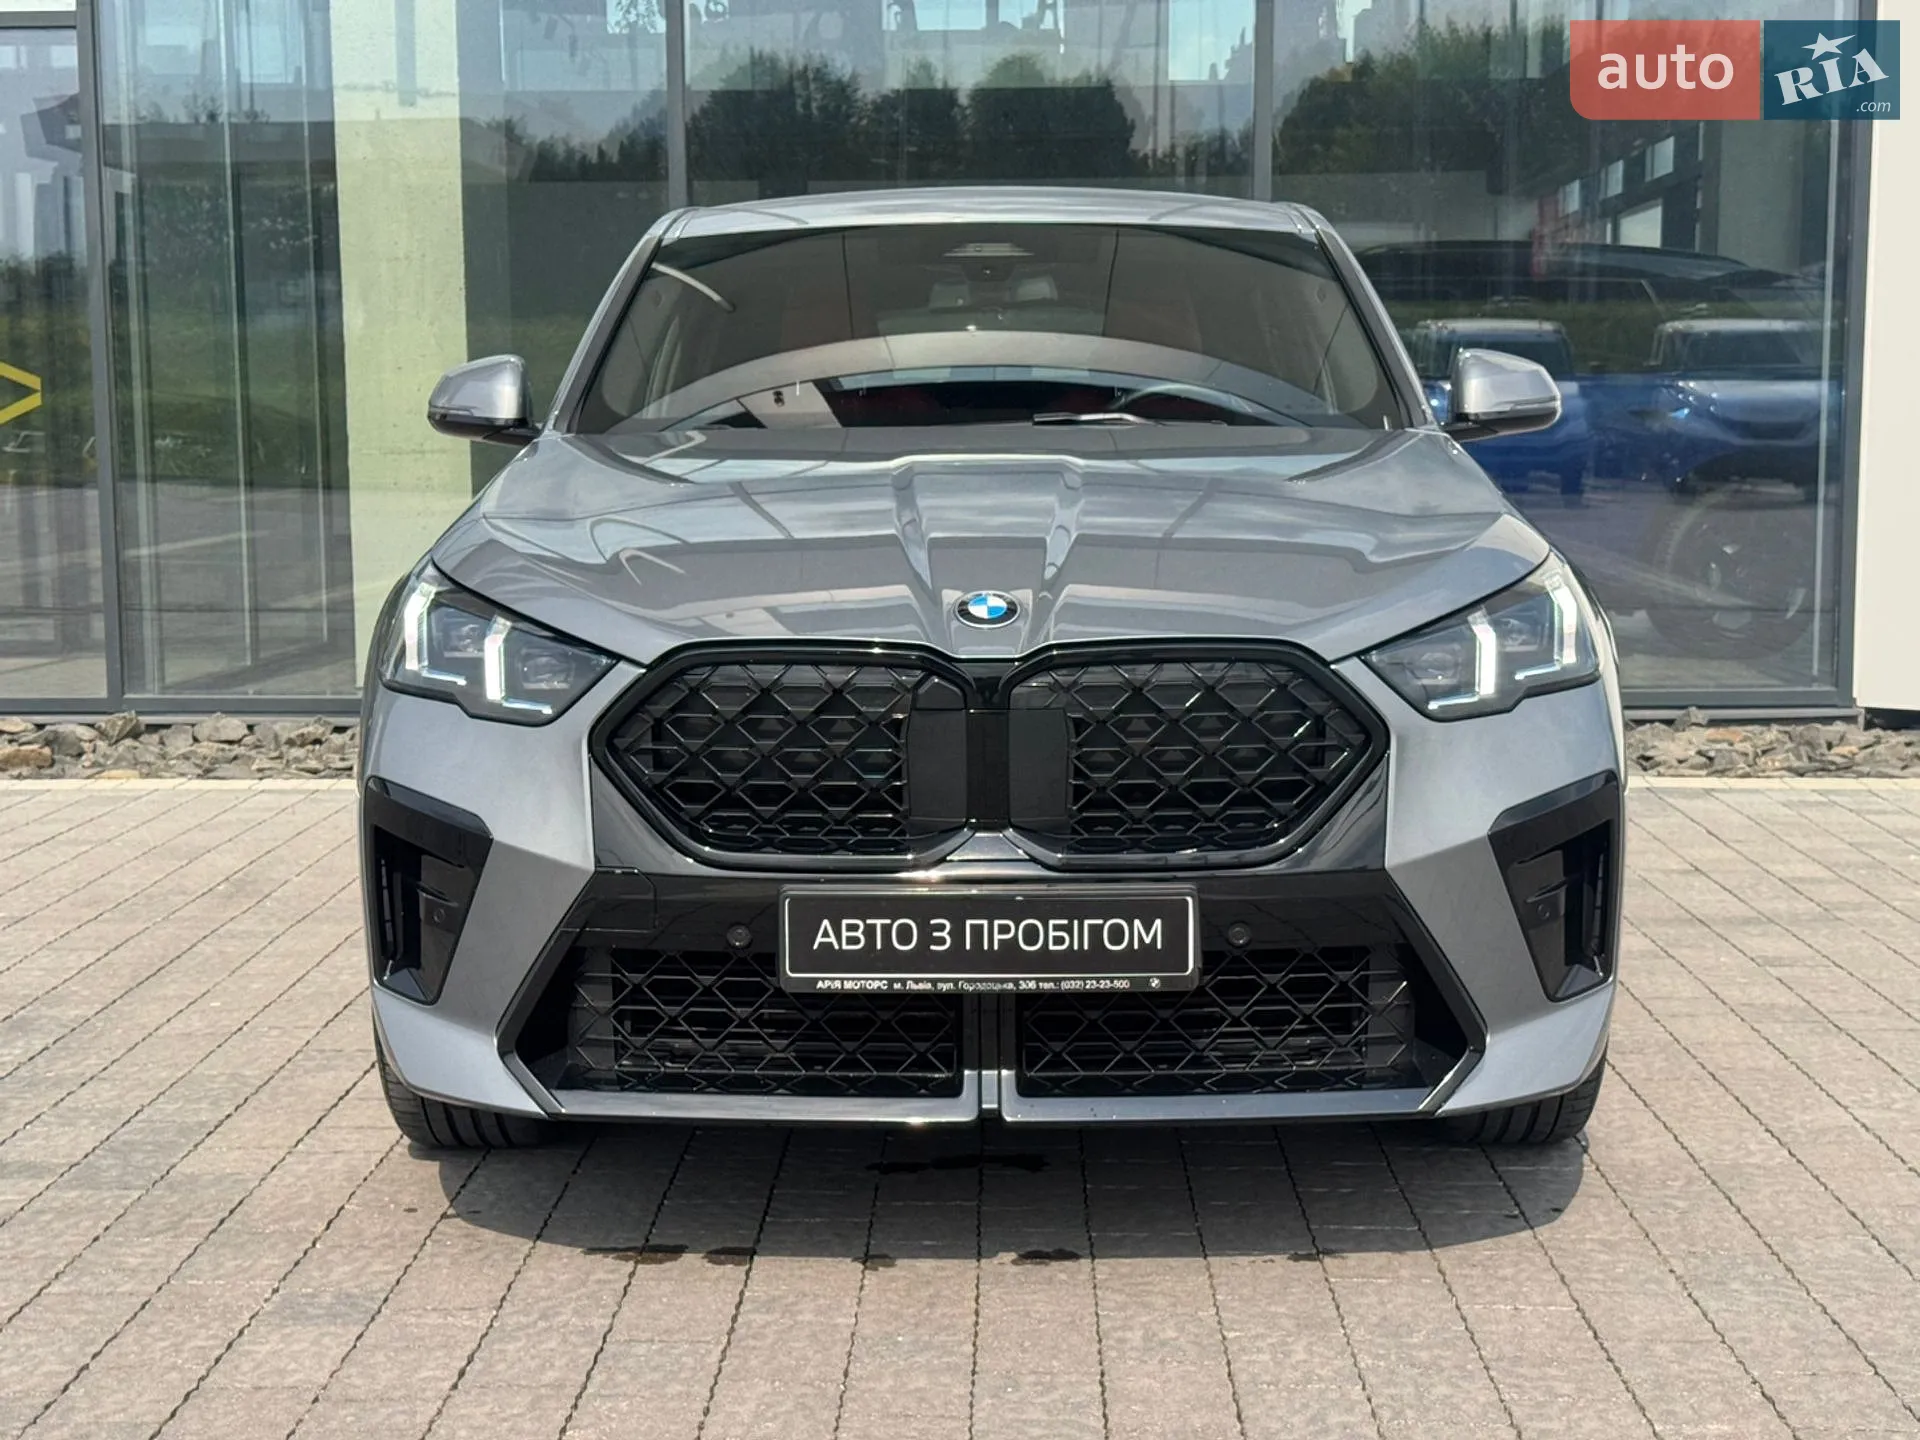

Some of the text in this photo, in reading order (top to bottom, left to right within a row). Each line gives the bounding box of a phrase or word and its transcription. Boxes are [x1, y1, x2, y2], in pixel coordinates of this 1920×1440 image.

[813, 918, 1162, 951] АВТО З ПРОБІГОМ
[843, 979, 888, 990] МОТОРС
[1060, 979, 1084, 991] (032)
[1085, 979, 1131, 990] 23-23-500
